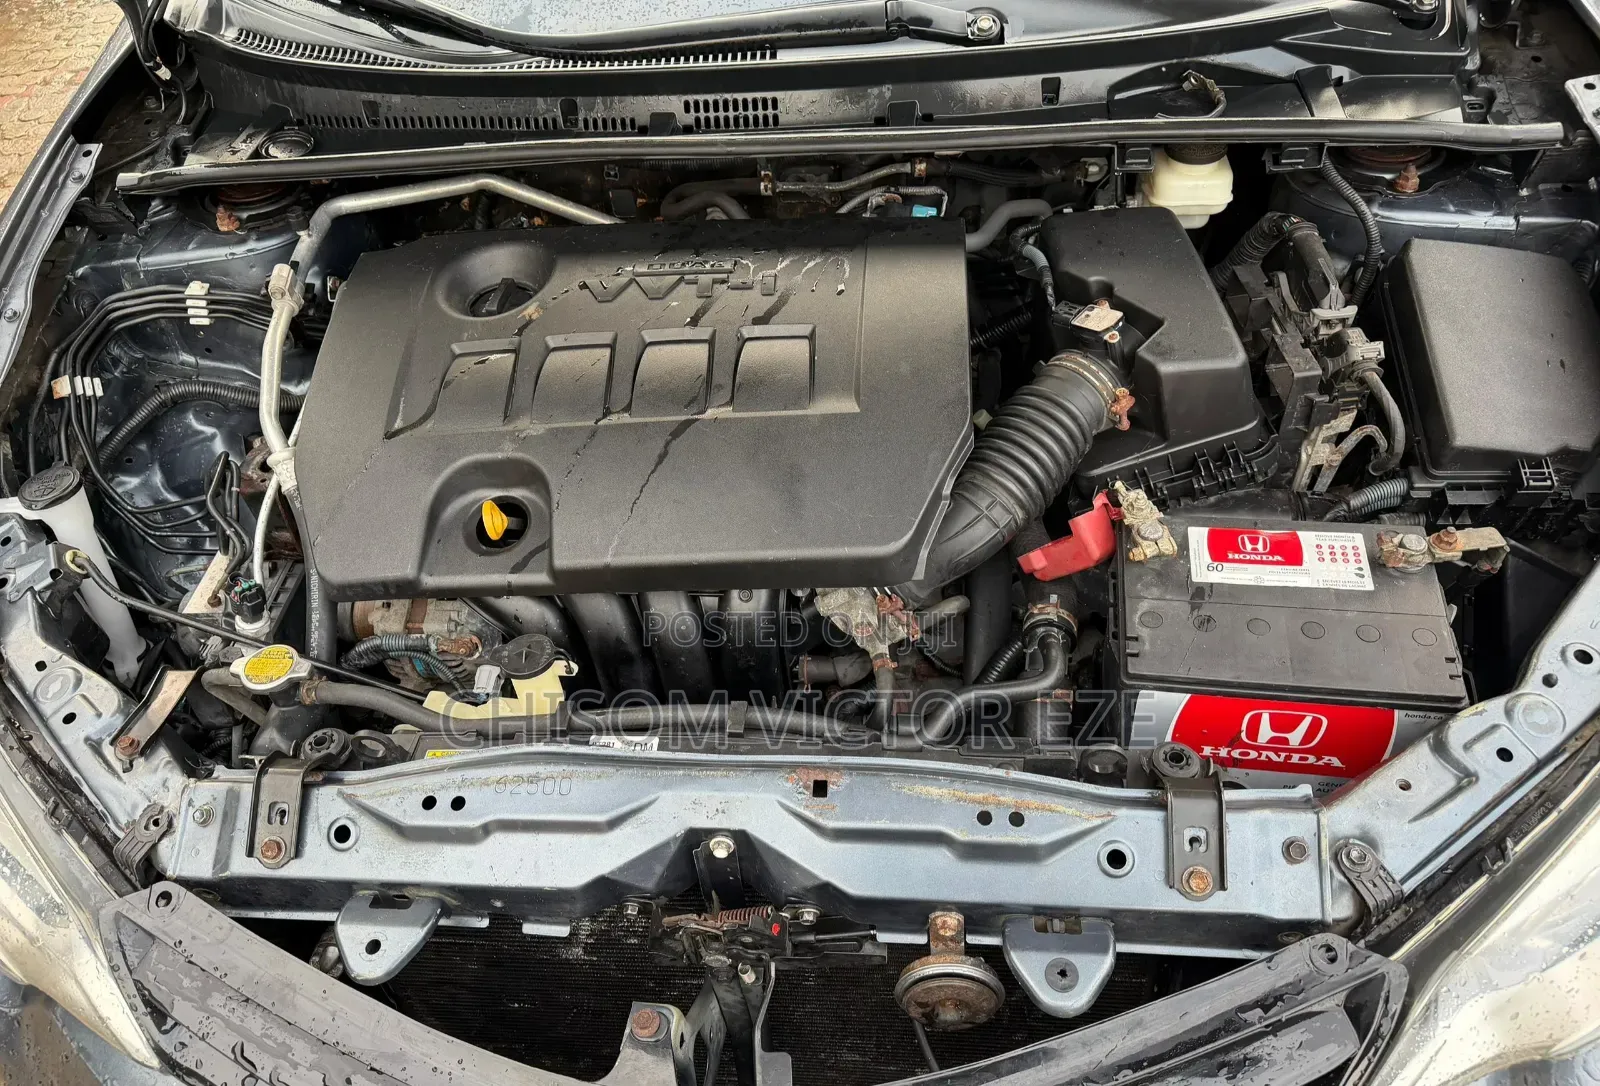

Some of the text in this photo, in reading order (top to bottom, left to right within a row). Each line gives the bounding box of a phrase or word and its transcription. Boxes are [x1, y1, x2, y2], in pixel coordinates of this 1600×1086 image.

[1226, 552, 1286, 562] HONDA
[1207, 562, 1224, 573] 60
[1404, 712, 1444, 721] honda.ca
[1199, 745, 1346, 768] HONDA
